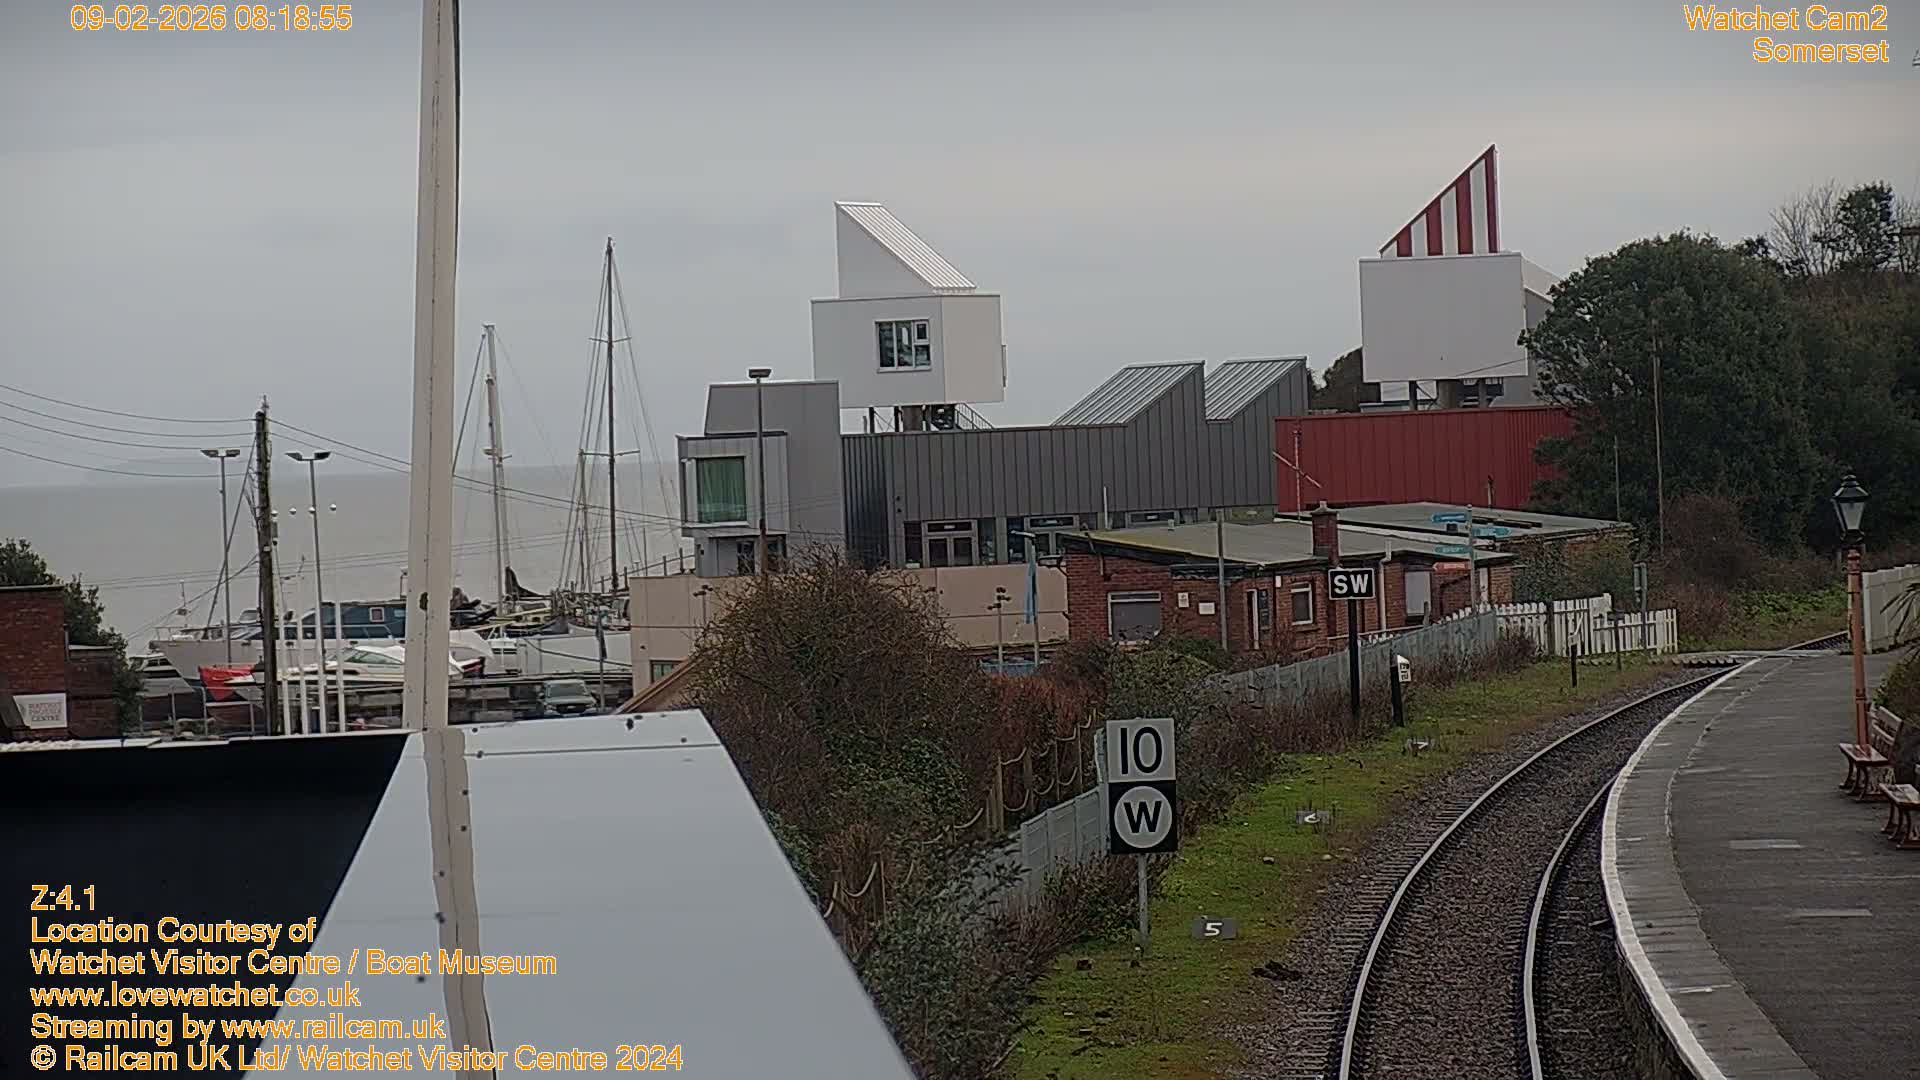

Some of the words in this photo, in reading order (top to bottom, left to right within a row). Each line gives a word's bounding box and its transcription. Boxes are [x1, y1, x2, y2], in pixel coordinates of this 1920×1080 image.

[1333, 573, 1369, 595] SW
[1120, 726, 1163, 775] 10
[1122, 800, 1163, 834] W
[1204, 922, 1223, 937] 5
